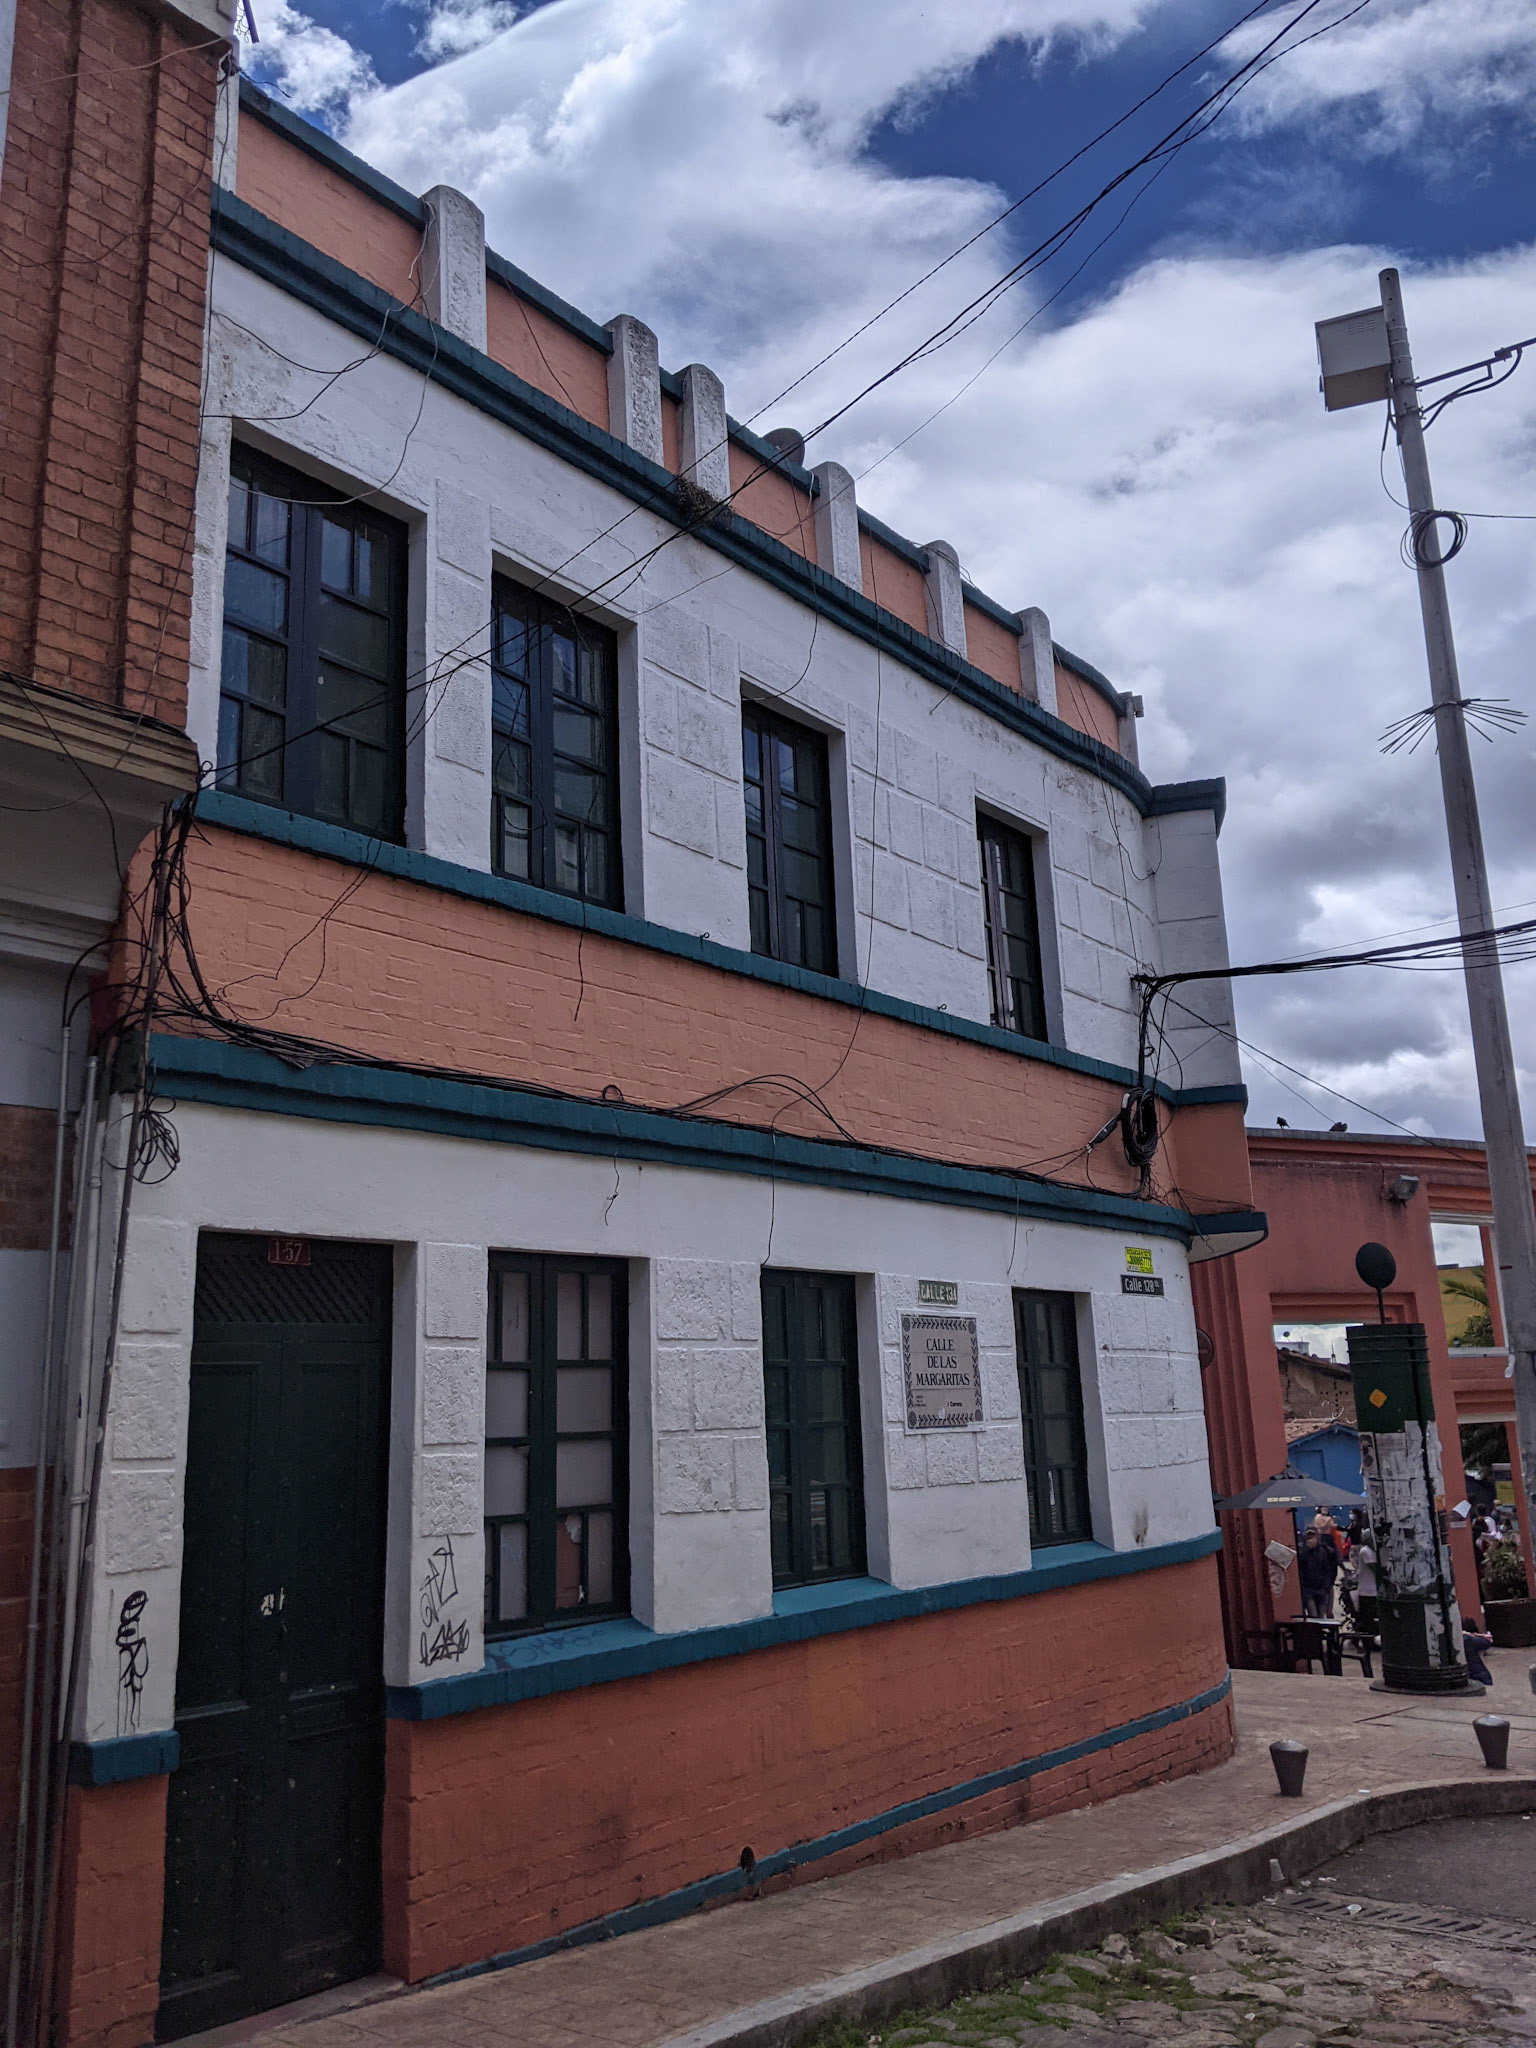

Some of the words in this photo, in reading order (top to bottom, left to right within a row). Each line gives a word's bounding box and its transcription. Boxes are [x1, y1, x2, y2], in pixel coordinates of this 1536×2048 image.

[1125, 1278, 1142, 1291] Calle
[920, 1284, 945, 1300] CALLE
[926, 1338, 954, 1351] CALLE
[927, 1355, 939, 1369] DE
[940, 1356, 957, 1369] LAS
[916, 1373, 970, 1386] MARGARITAS
